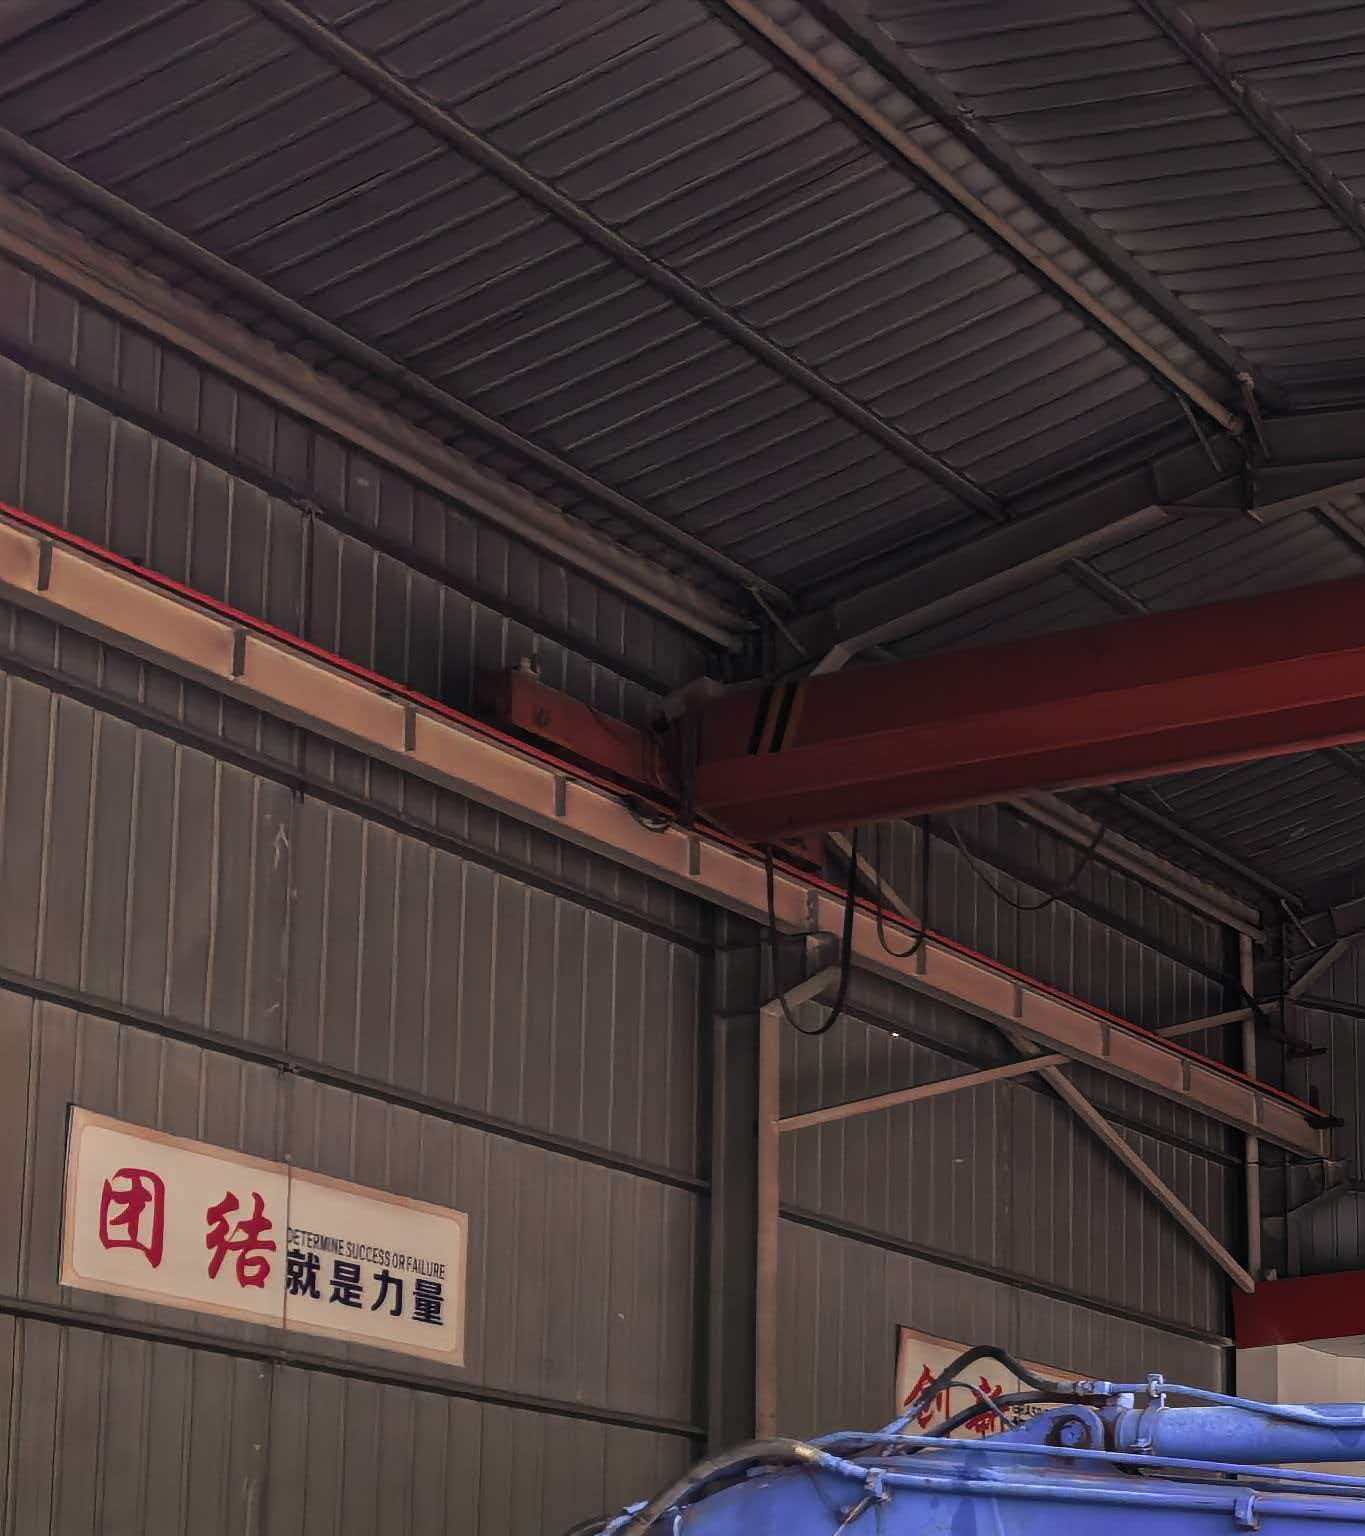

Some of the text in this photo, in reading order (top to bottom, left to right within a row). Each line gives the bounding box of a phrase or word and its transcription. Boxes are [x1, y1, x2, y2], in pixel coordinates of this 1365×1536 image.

[99, 1167, 277, 1289] 团结
[287, 1227, 446, 1281] DETERMINE SUCCESS OR FAILURE
[286, 1249, 445, 1326] 就是力量
